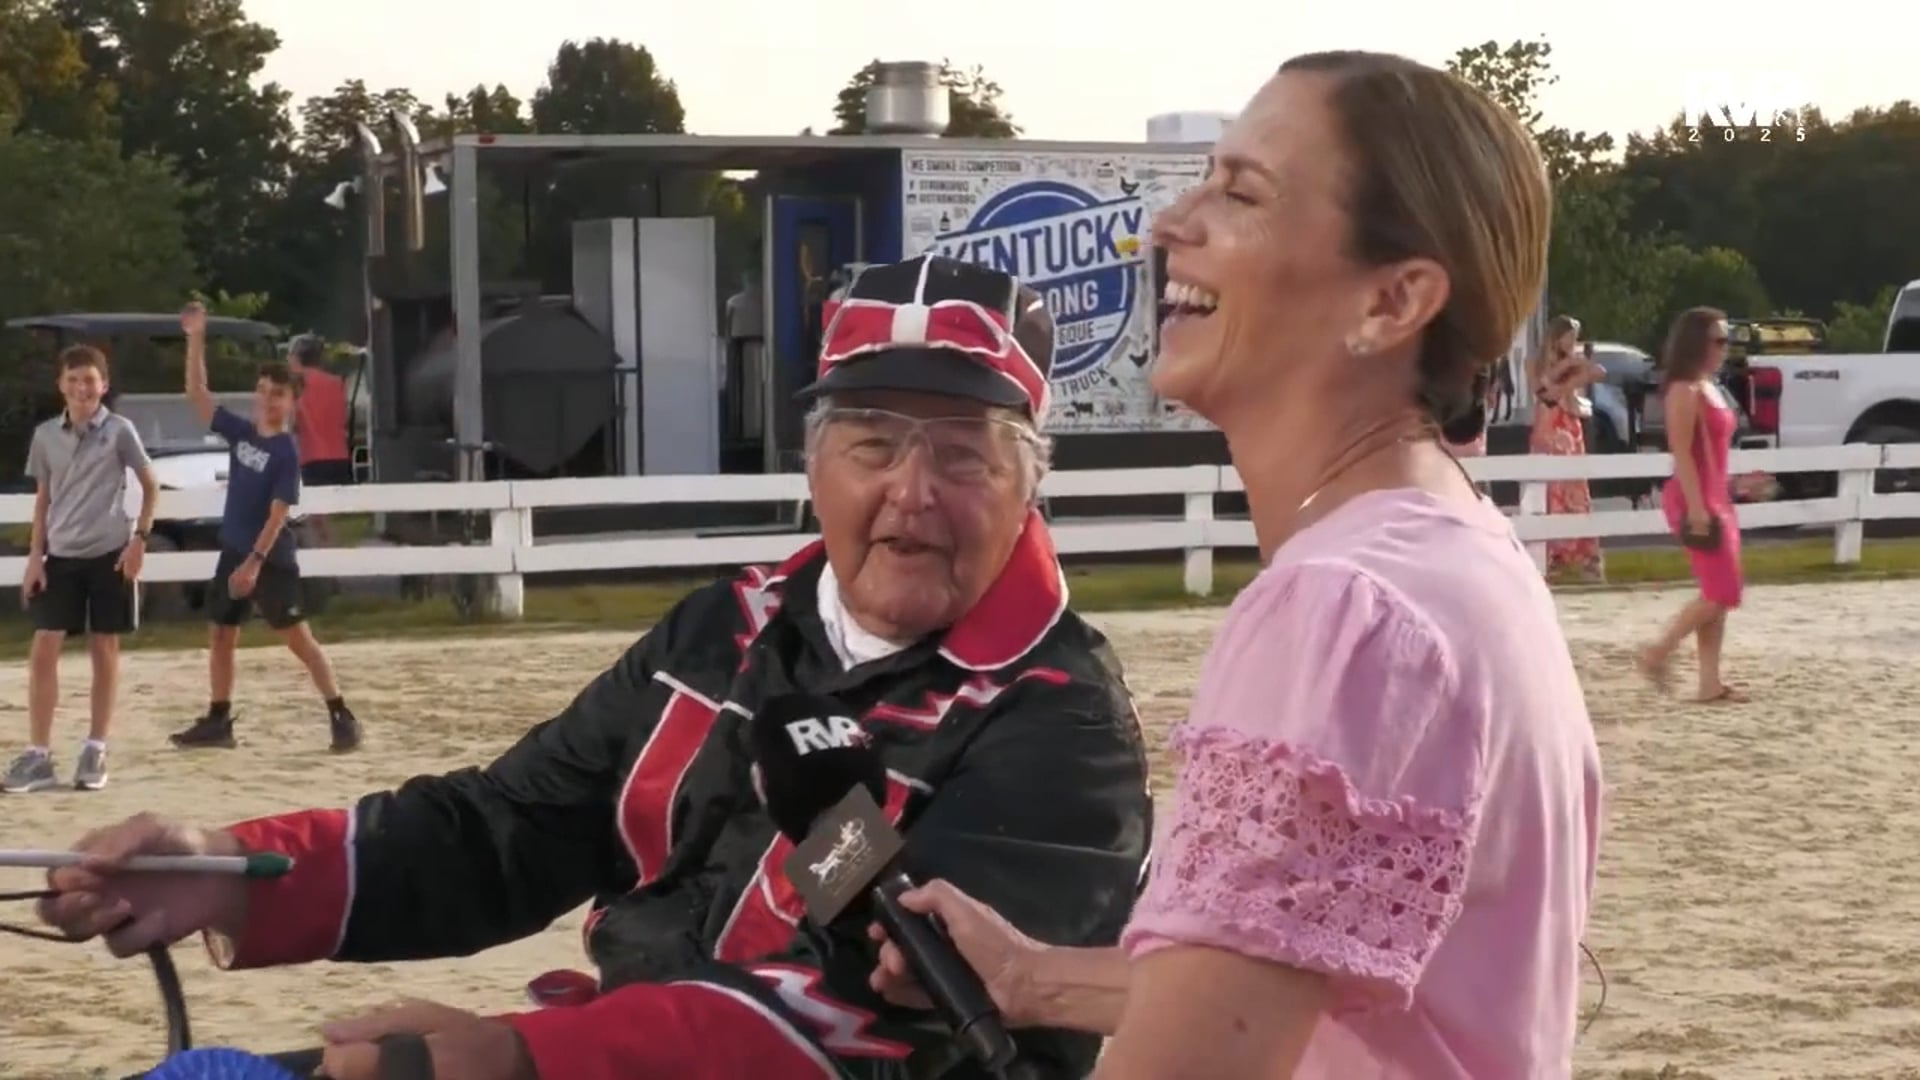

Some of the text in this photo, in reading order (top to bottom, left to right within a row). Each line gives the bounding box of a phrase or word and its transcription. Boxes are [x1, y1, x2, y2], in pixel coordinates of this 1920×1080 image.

[1046, 279, 1099, 319] ONG
[1057, 321, 1095, 346] EQUE
[1060, 362, 1110, 397] TRUCK
